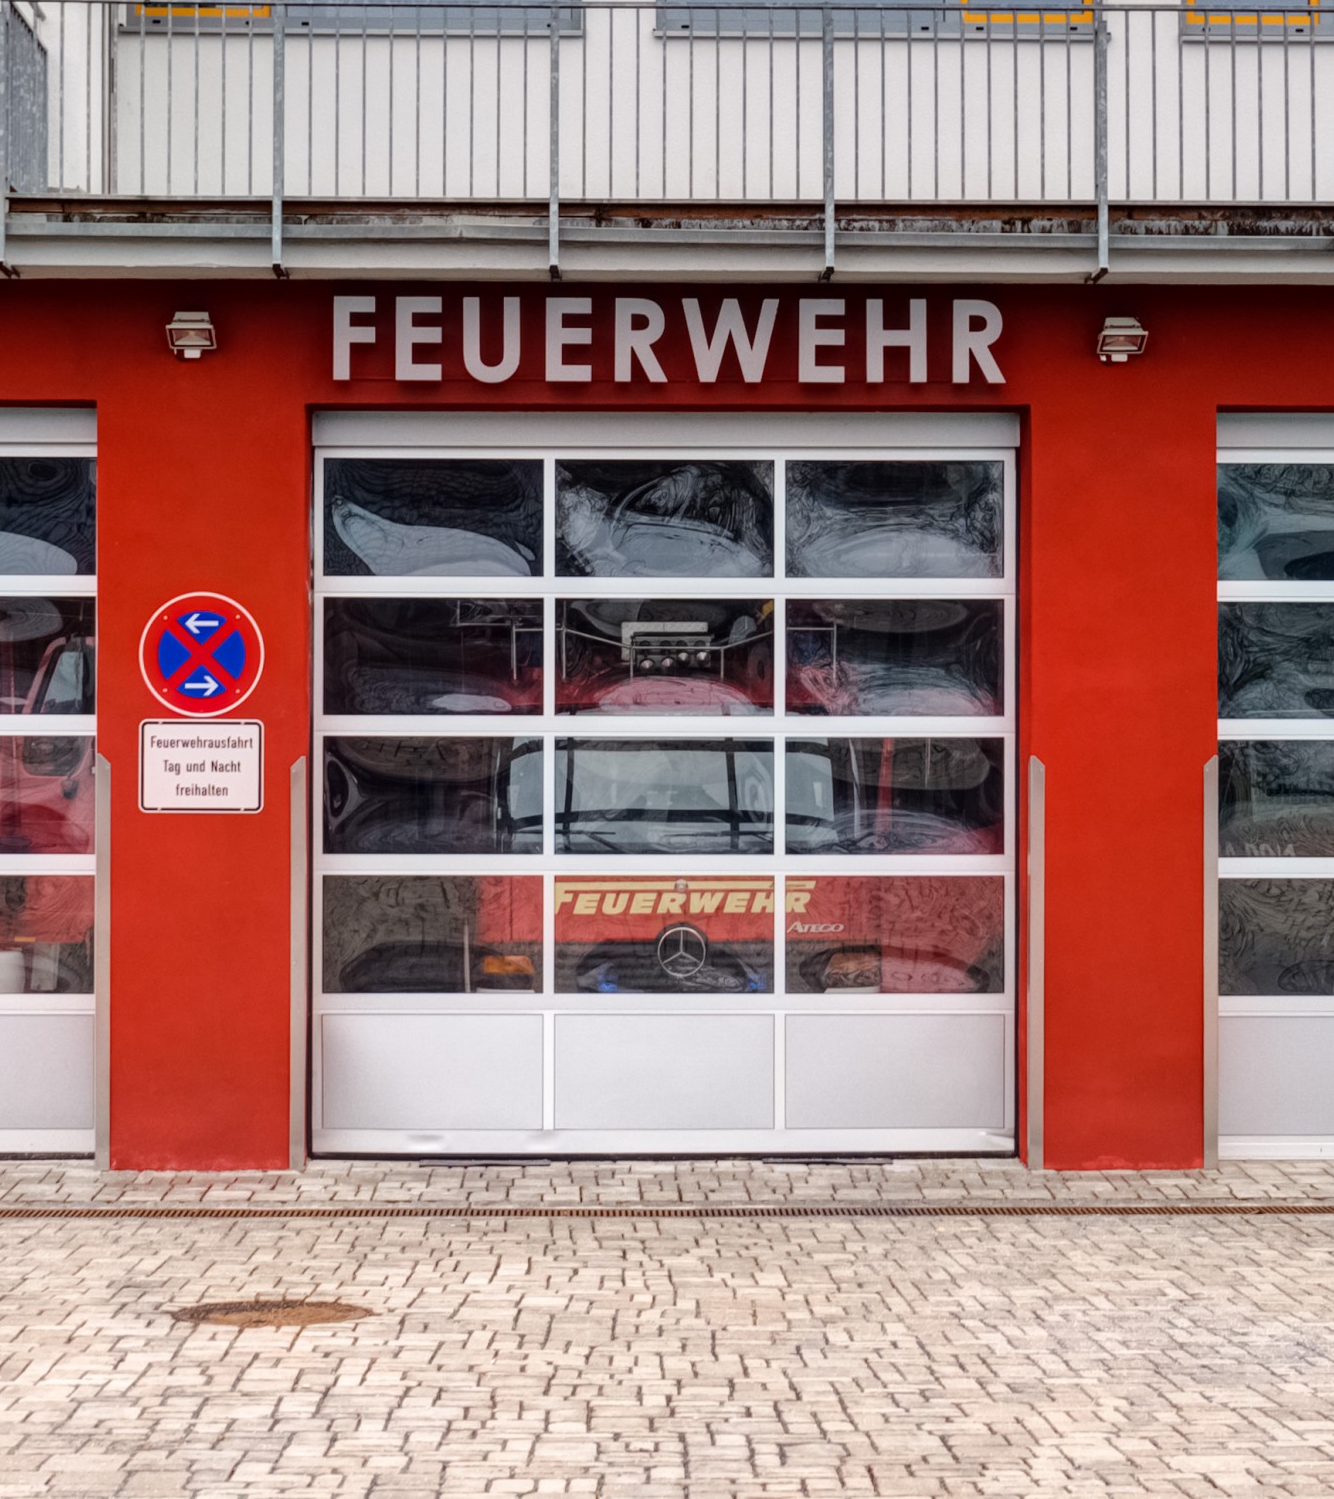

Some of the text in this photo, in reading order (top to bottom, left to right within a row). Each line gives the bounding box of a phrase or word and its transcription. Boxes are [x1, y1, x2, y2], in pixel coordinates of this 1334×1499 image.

[333, 296, 1006, 384] FEUERWEHR
[150, 735, 254, 749] Feuerwehrausfahrt
[163, 760, 241, 775] Tag und Nacht
[176, 783, 229, 796] freihalten
[555, 881, 813, 915] FEUERWEHR
